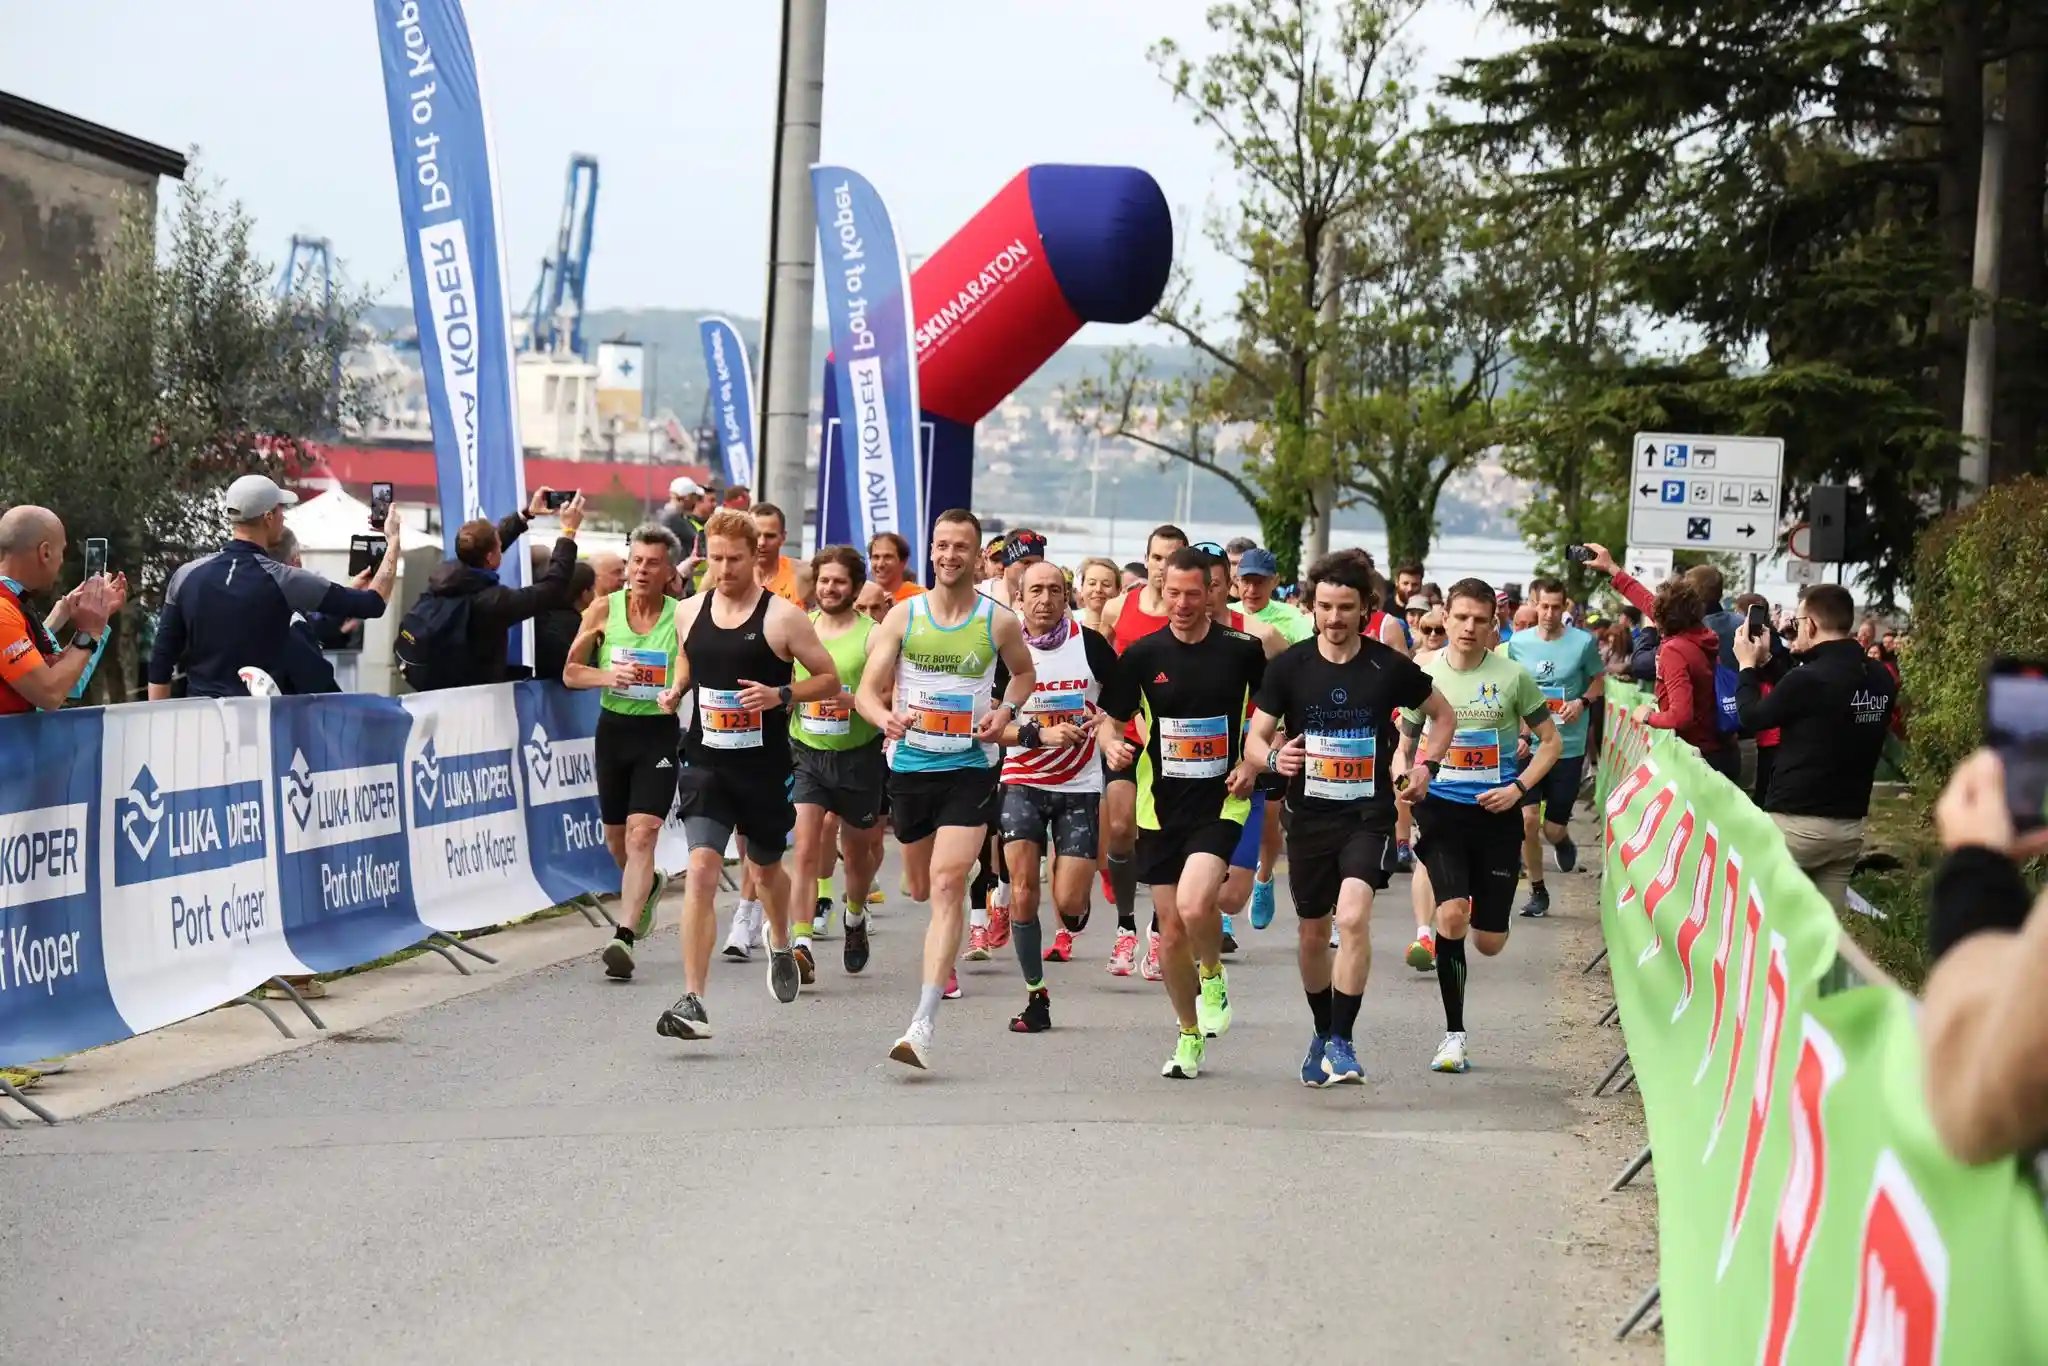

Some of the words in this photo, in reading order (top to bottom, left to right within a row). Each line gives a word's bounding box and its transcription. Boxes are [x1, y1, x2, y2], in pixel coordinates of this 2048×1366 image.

[1667, 483, 1680, 501] P
[932, 654, 962, 664] BOVEC
[1850, 689, 1889, 711] 44CUP
[720, 713, 750, 729] 123
[942, 716, 949, 732] 1
[1192, 742, 1213, 756] 48
[1463, 751, 1484, 766] 42
[556, 753, 592, 787] LUKA
[1332, 761, 1364, 778] 191
[316, 788, 351, 829] LUKA
[354, 782, 397, 825] KOPER
[441, 769, 474, 809] LUKA
[168, 808, 223, 858] LUKA
[563, 813, 594, 852] Port
[445, 837, 473, 879] Port
[471, 831, 484, 873] of
[482, 829, 517, 878] Koper
[321, 863, 350, 910] Port
[350, 856, 364, 904] of
[364, 853, 400, 909] Koper
[171, 893, 214, 950] Port
[11, 925, 80, 995] Koper
